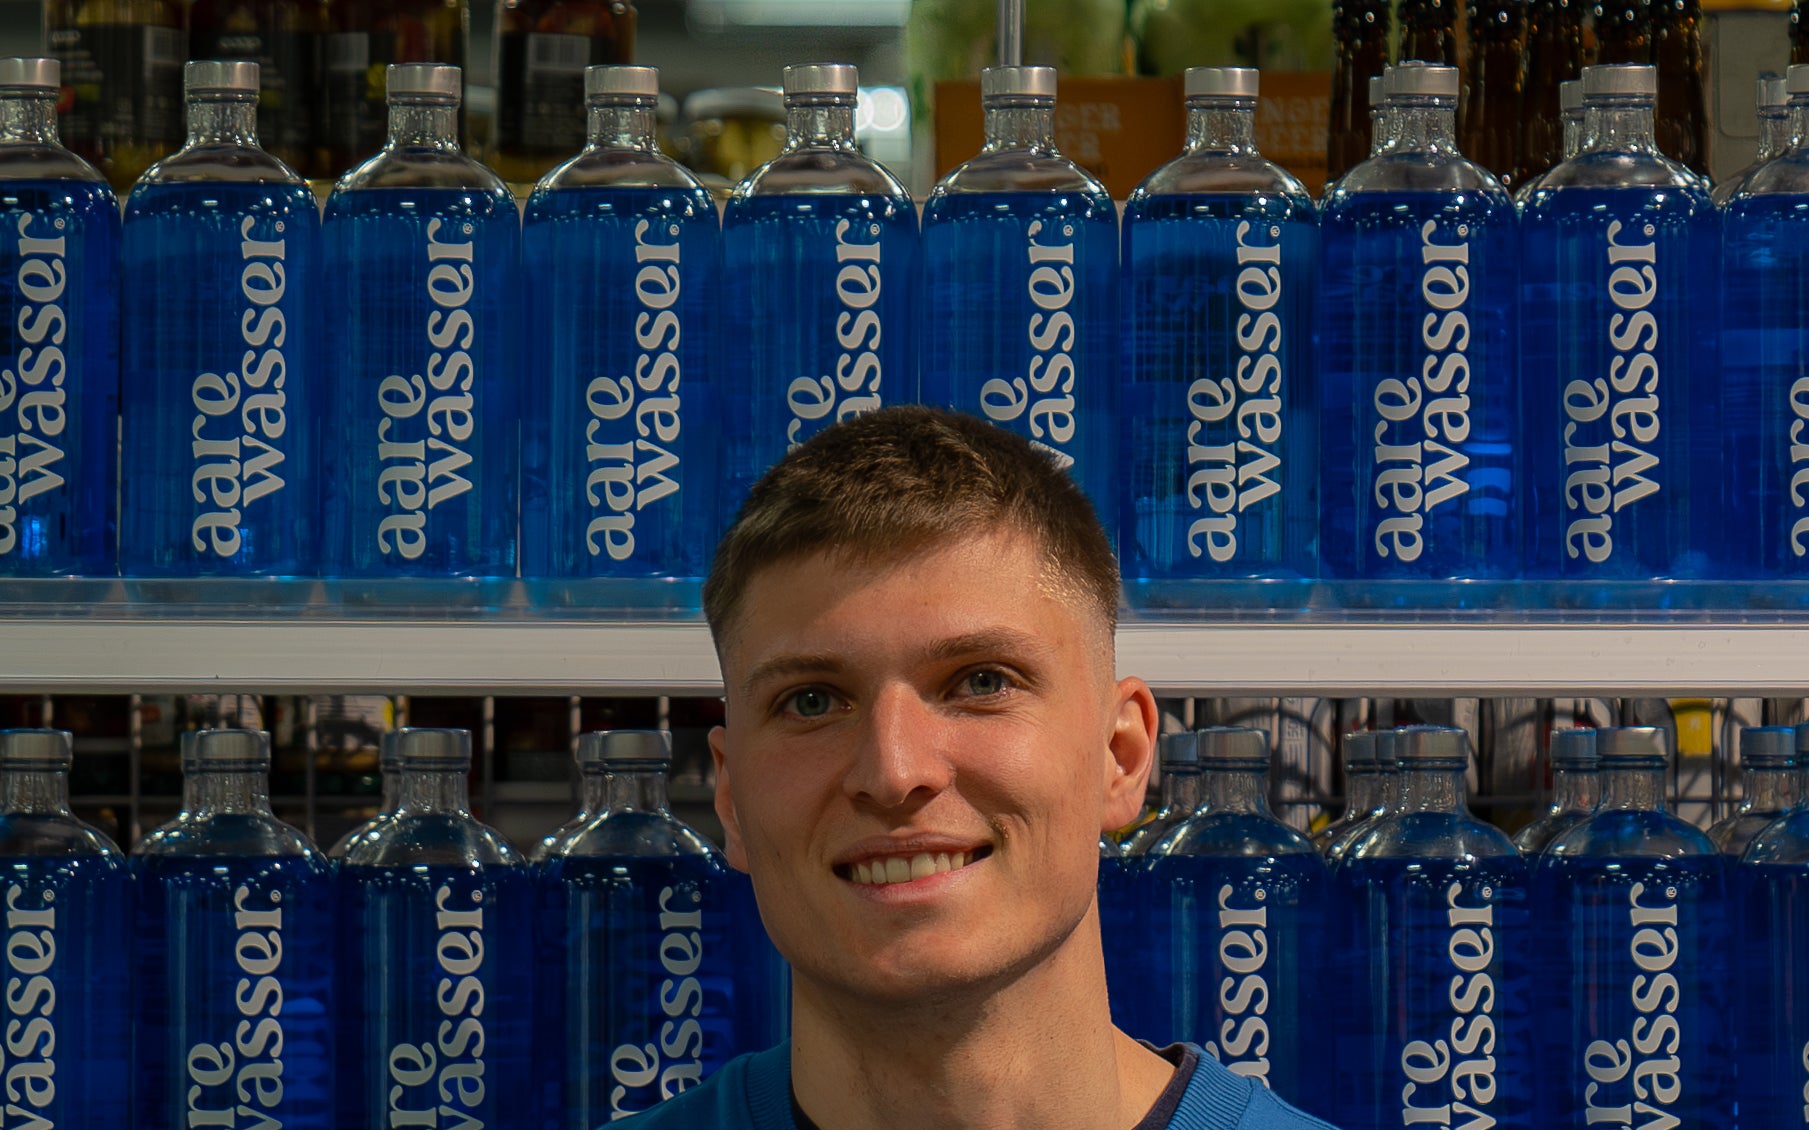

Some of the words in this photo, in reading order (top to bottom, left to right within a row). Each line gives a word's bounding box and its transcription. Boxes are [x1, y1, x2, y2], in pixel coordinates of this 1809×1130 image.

[18, 213, 65, 504] wasser
[242, 215, 285, 507] wasser
[428, 218, 473, 510] wasser
[635, 219, 680, 511] wasser
[836, 219, 881, 425] asser
[1237, 220, 1281, 512] wasser
[1422, 219, 1470, 512] wasser
[1608, 219, 1660, 512] wasser
[193, 373, 240, 557] aare
[378, 375, 425, 559] aare
[587, 376, 634, 560] aare
[1188, 378, 1236, 562] aare
[1375, 377, 1423, 562] aare
[1565, 378, 1612, 562] aare
[660, 887, 702, 1102] asser
